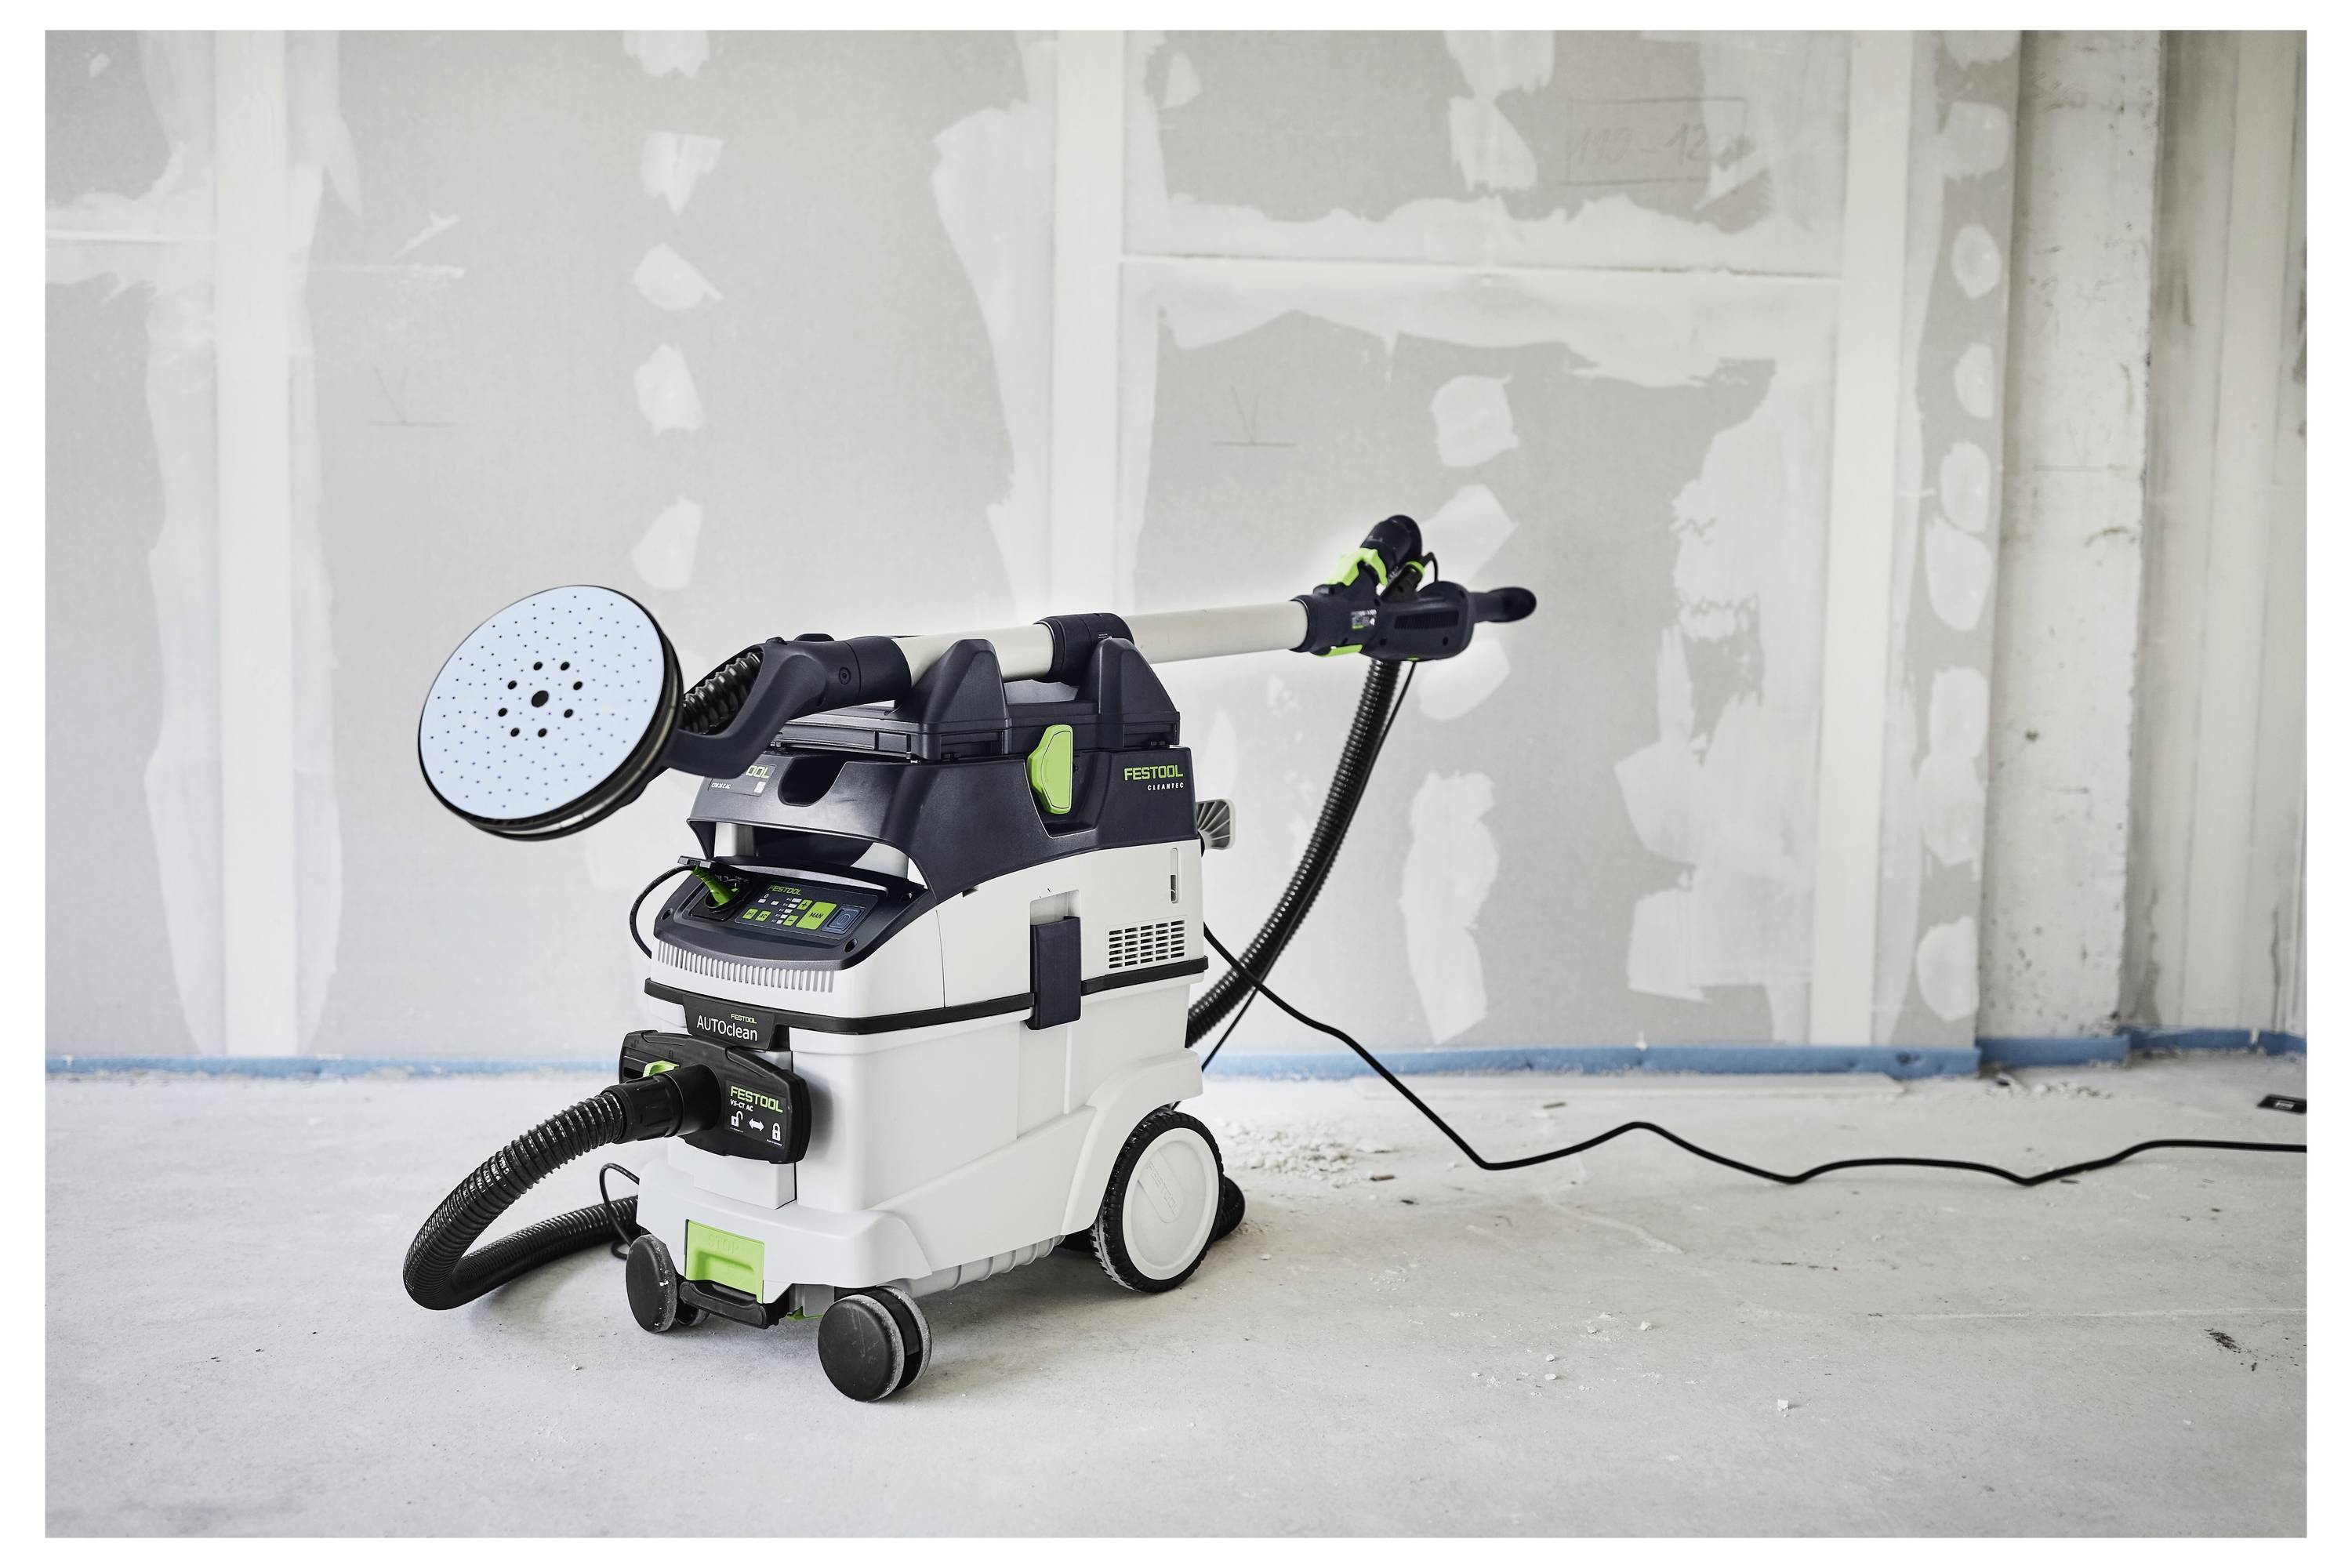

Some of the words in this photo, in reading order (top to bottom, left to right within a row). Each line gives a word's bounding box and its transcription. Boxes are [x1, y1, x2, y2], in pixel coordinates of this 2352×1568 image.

[1123, 764, 1184, 781] FESTOOL
[768, 884, 801, 895] FESTOOL
[696, 1014, 758, 1042] AUTOclean
[731, 1013, 757, 1024] FESTOOL
[730, 1085, 783, 1113] FESTOOL
[730, 1098, 746, 1109] VS-CT
[1145, 1160, 1179, 1217] FESTOOL
[708, 1233, 739, 1254] STOP
